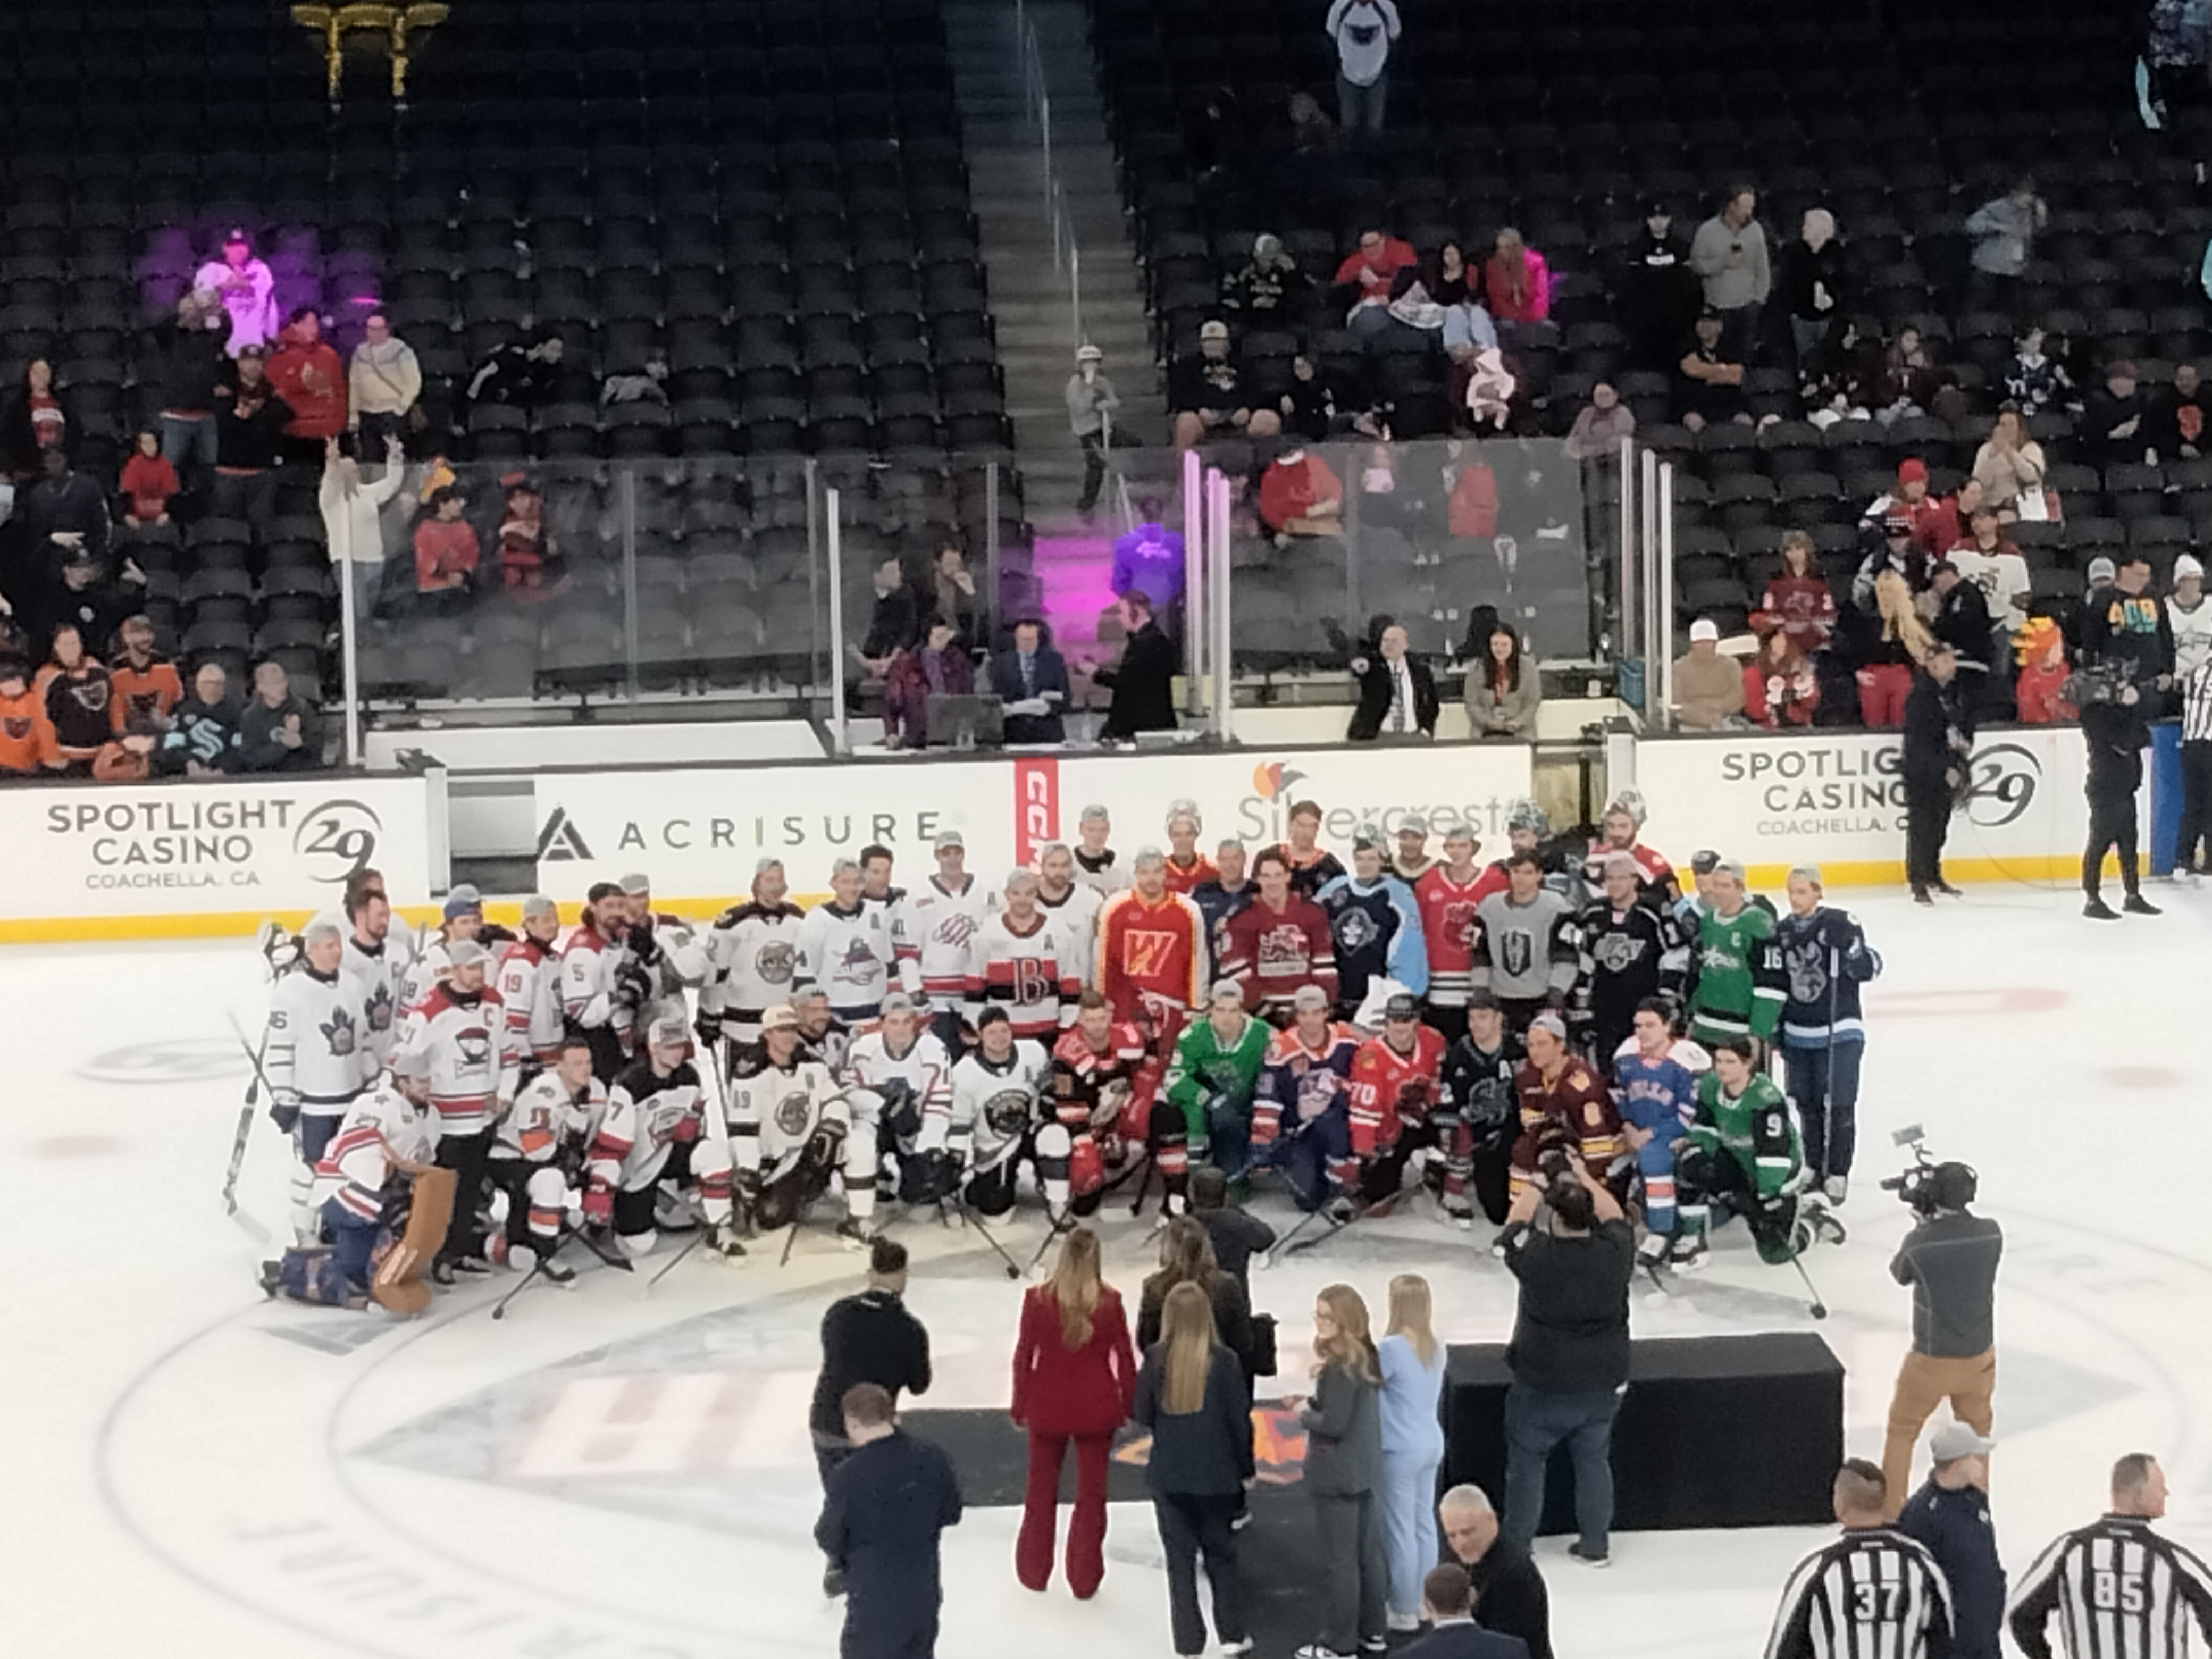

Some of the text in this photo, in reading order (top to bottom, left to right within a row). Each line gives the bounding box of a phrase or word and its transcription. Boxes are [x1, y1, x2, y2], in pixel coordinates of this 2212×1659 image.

[1722, 746, 1905, 781] SPOTLIG
[1969, 764, 2036, 825] 29
[48, 800, 296, 833] SPOTLIGHT
[618, 811, 939, 850] ACRISURE
[92, 835, 252, 866] CASINO
[305, 819, 376, 881] 29
[231, 871, 261, 886] CA
[1044, 933, 1054, 951] A
[1763, 946, 1783, 970] 16
[505, 974, 522, 993] 19
[572, 963, 586, 982] 5
[1010, 957, 1049, 1007] B
[483, 1007, 495, 1026] C
[1350, 1082, 1377, 1105] 70
[610, 1101, 624, 1122] 7
[1765, 1112, 1782, 1138] 9
[1854, 1582, 1900, 1622] 37
[2093, 1572, 2144, 1612] 85
